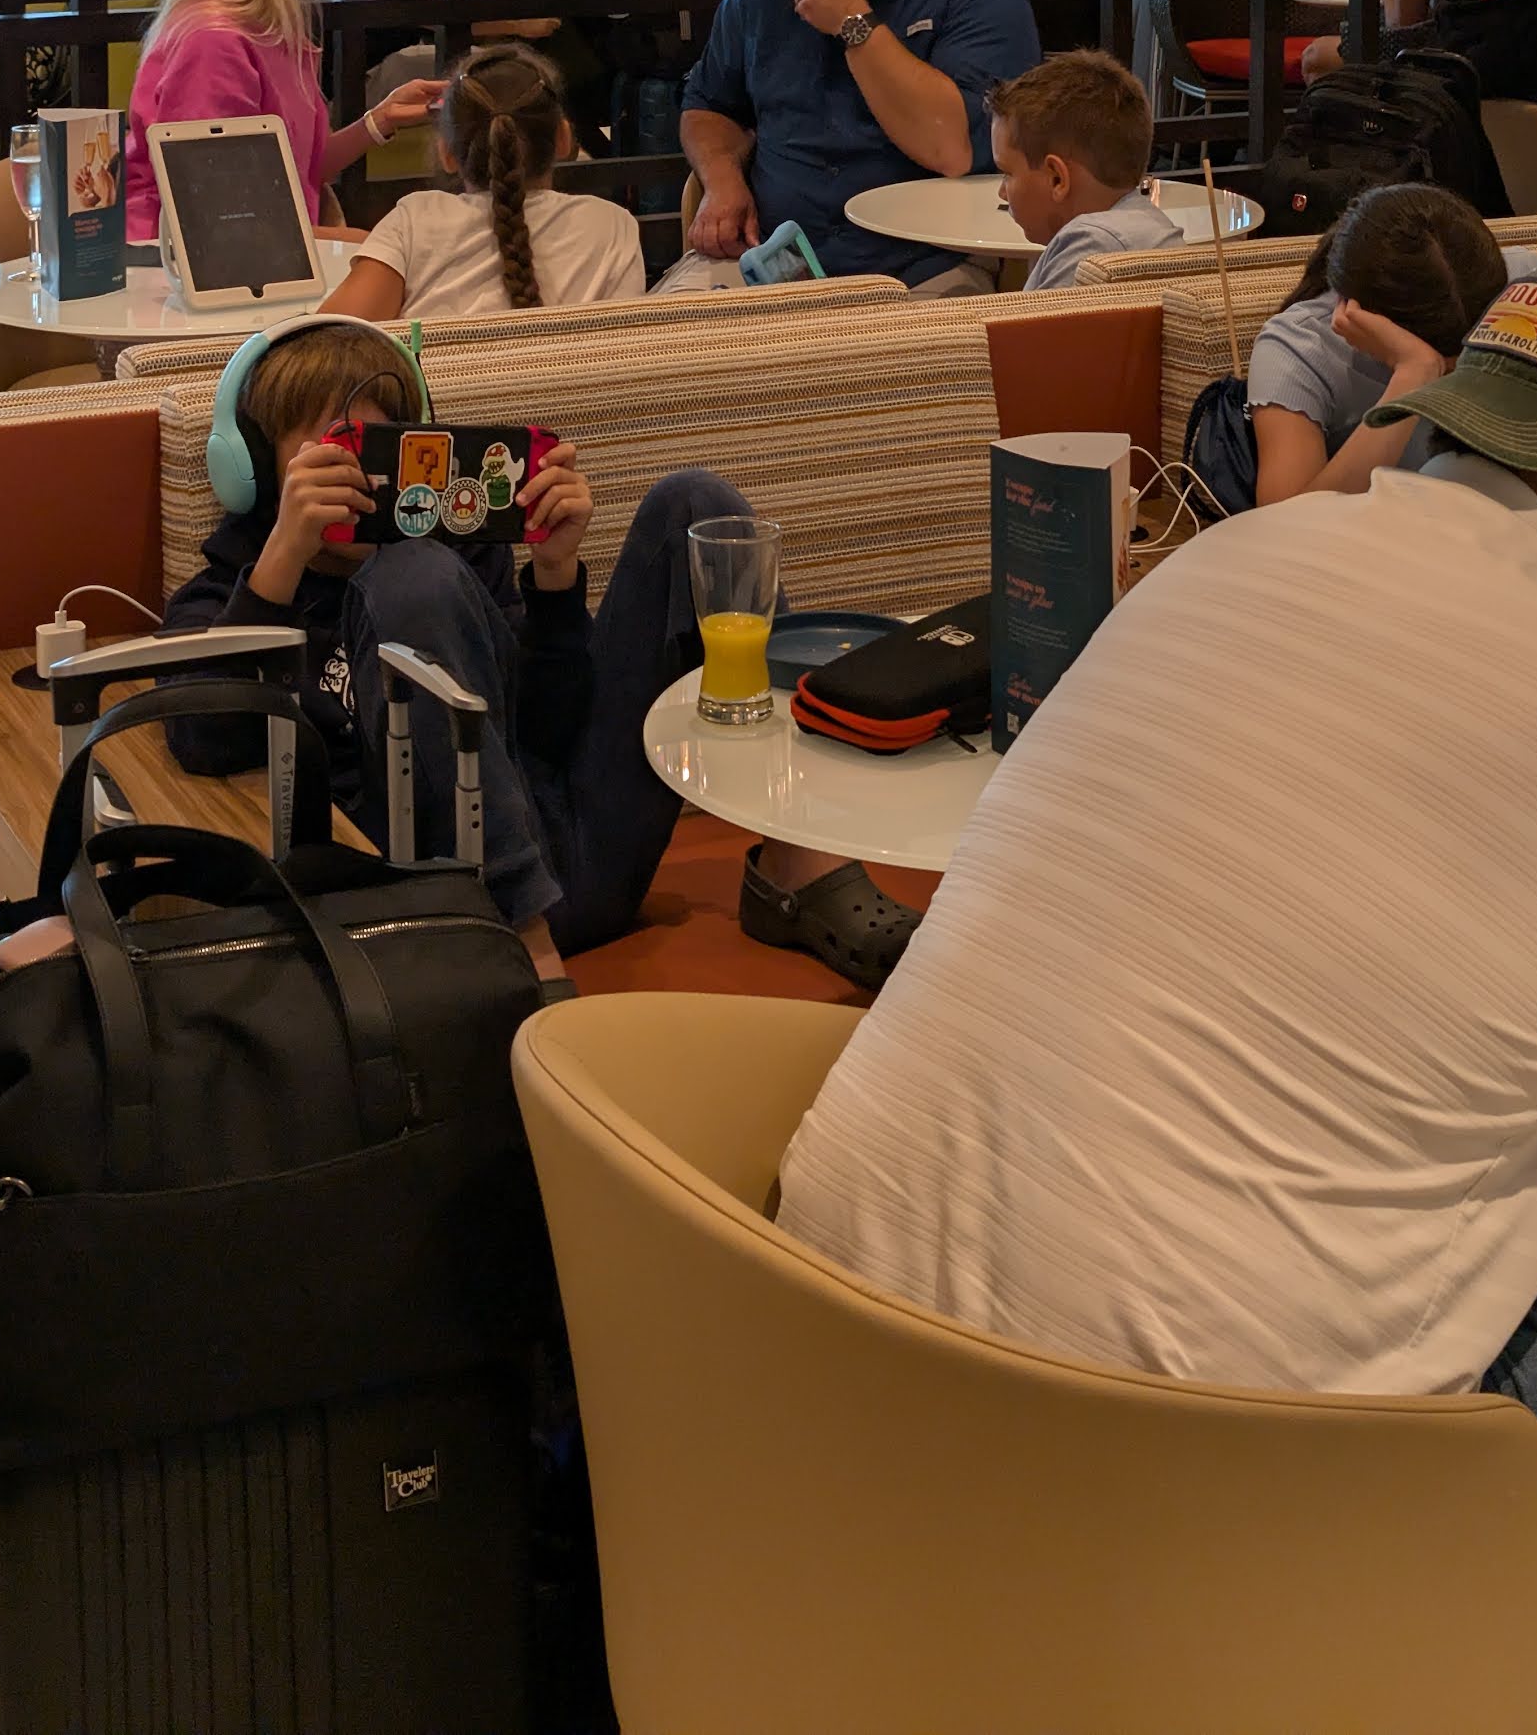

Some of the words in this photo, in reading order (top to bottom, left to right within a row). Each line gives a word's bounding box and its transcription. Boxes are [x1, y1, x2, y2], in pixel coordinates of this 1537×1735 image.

[1472, 329, 1499, 343] NORTH
[406, 489, 428, 504] GET
[401, 513, 434, 532] SALTY
[386, 1465, 436, 1488] Travelers
